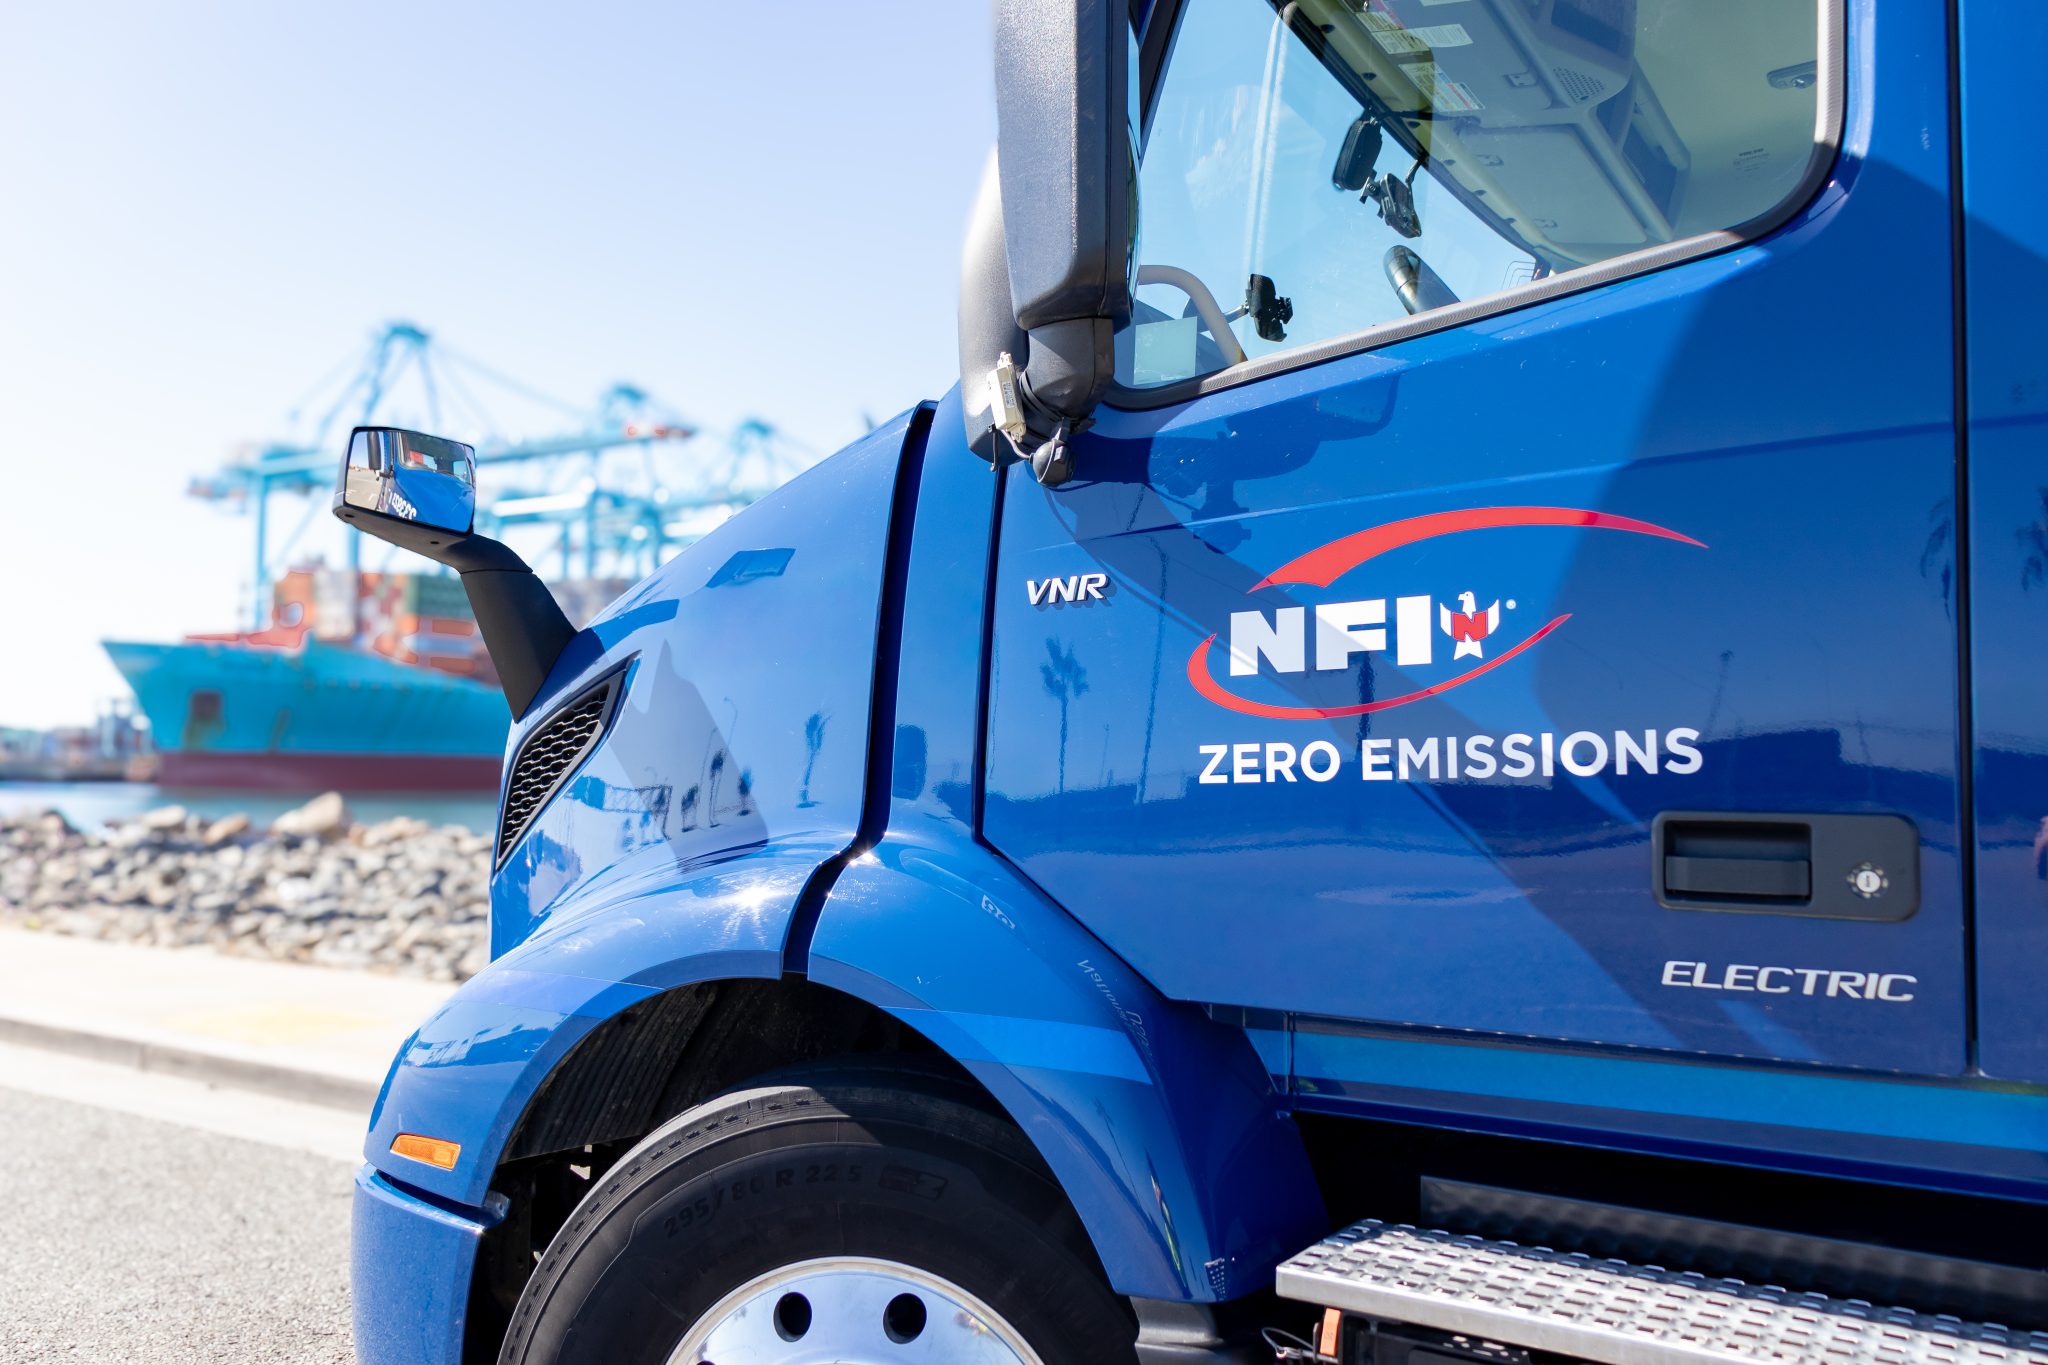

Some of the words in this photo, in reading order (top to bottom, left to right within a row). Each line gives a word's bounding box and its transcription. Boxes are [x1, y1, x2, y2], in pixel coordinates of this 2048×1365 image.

[1026, 573, 1107, 605] VNR
[1230, 595, 1432, 677] NFI
[1199, 740, 1341, 784] ZERO
[1362, 727, 1703, 781] EMISSIONS
[1661, 960, 1918, 1002] ELECTRIC
